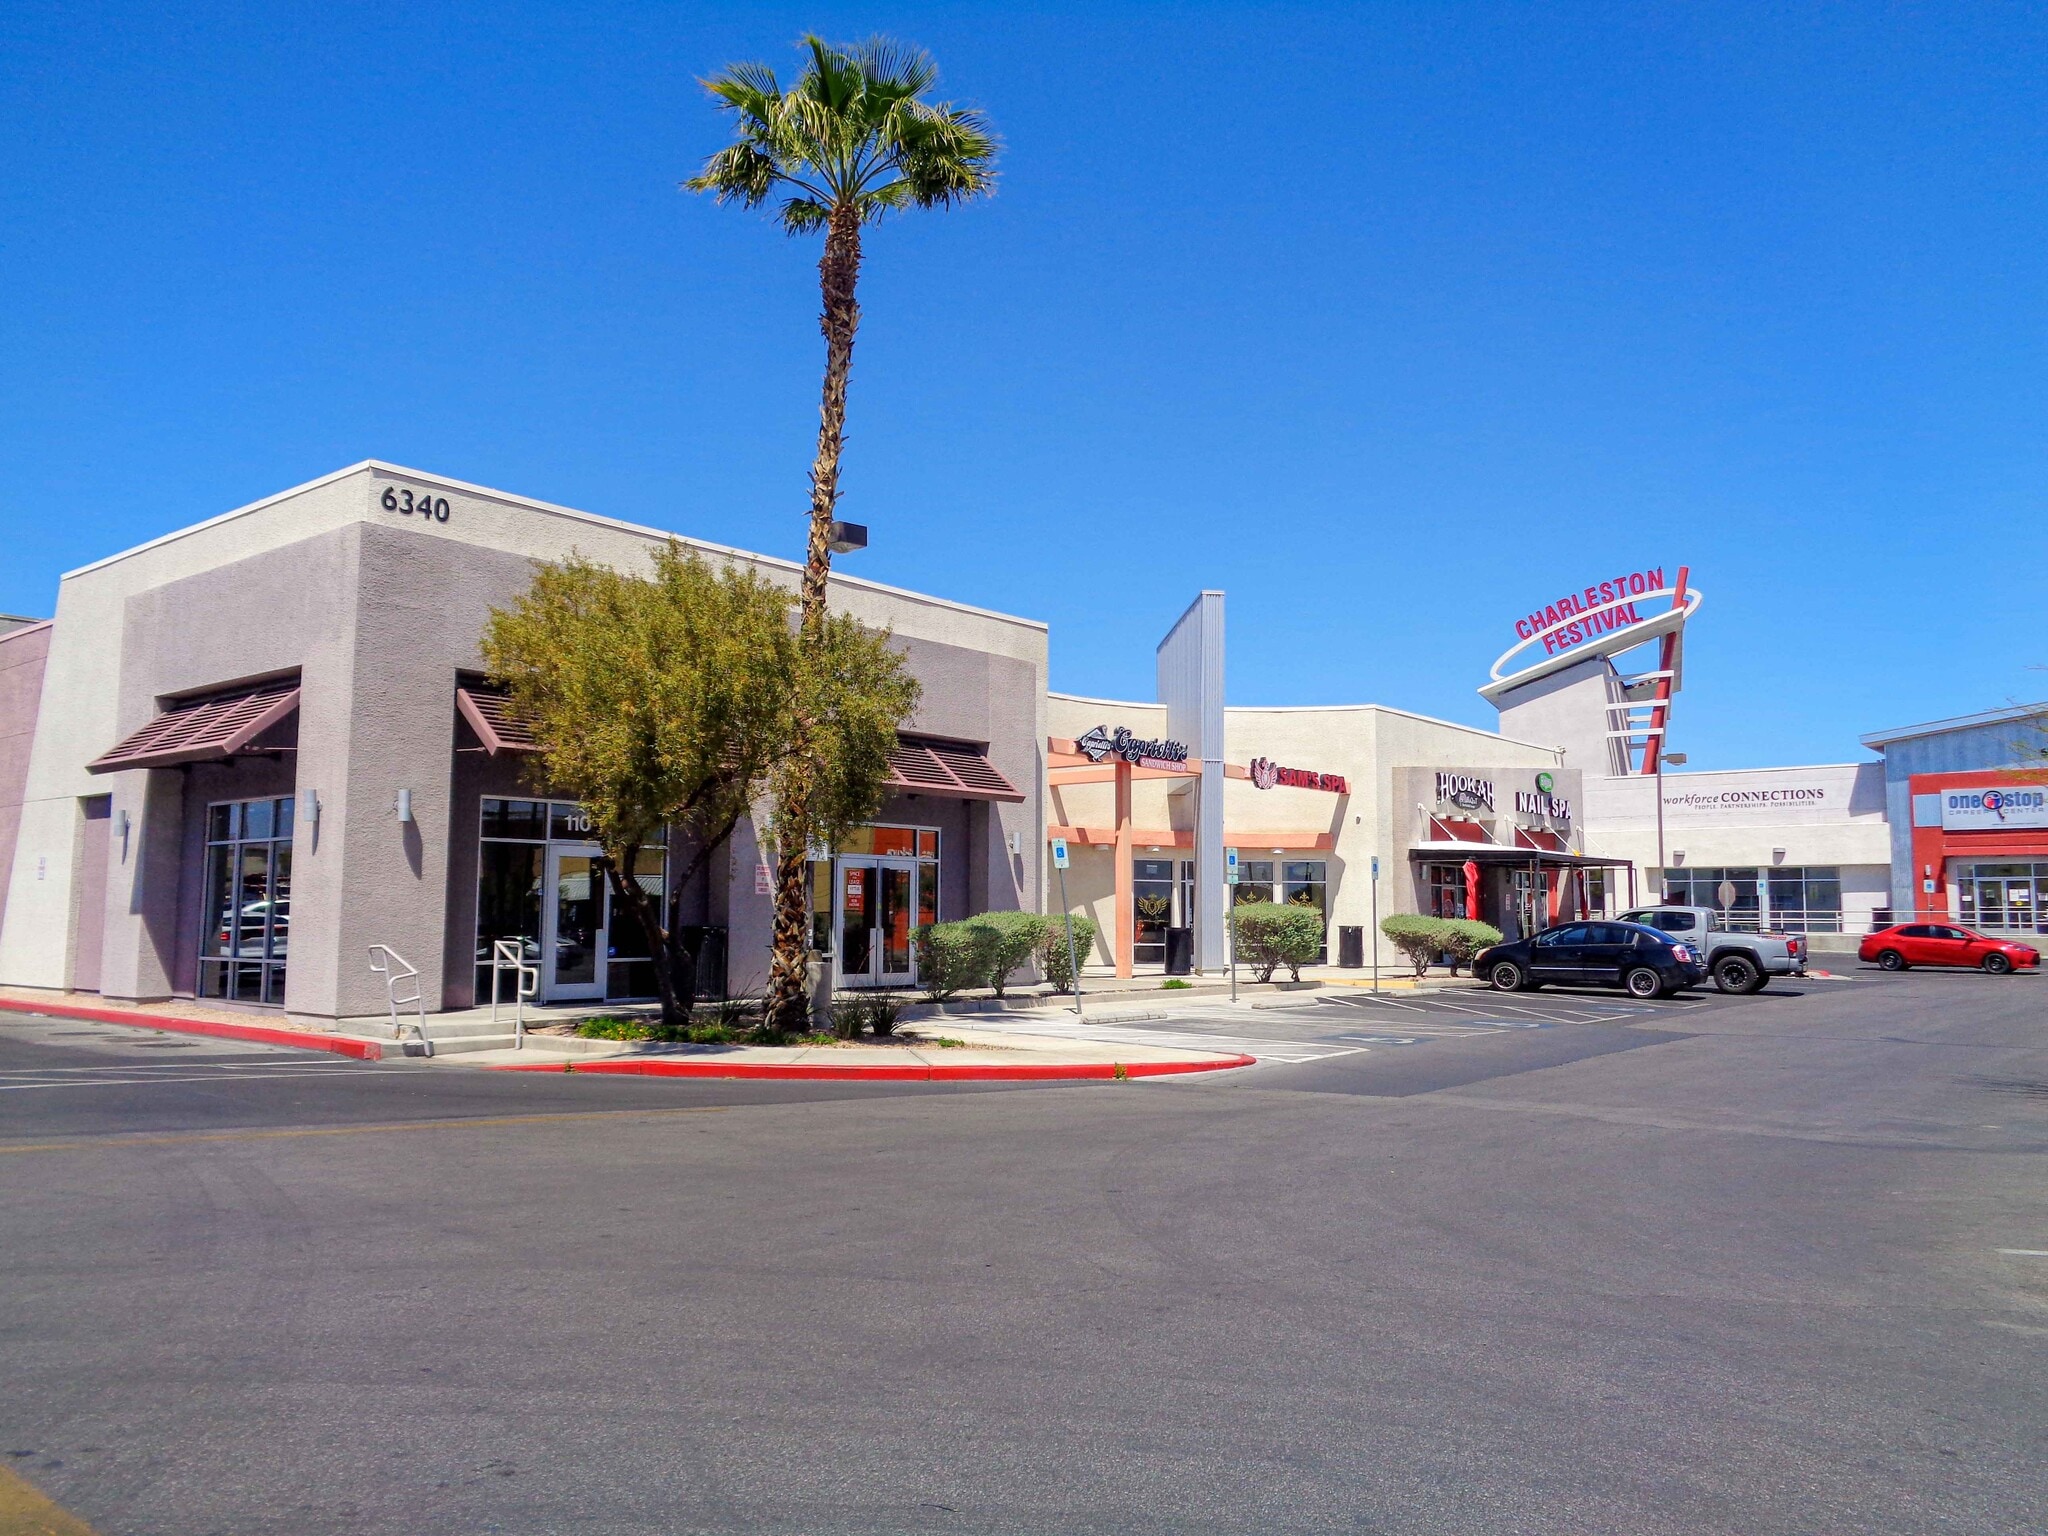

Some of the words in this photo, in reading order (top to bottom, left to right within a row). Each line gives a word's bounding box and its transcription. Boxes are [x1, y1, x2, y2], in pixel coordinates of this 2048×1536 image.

[381, 486, 450, 523] 6340
[1515, 568, 1664, 641] CHARLESTON
[1542, 602, 1644, 655] FESTIVAL
[1140, 758, 1171, 770] SANDWICH
[1171, 762, 1187, 772] SHOP
[1323, 774, 1347, 793] SPA
[1438, 772, 1495, 811] HOOKAH
[1518, 792, 1549, 815] NAIL
[1551, 798, 1573, 819] SPA
[1663, 793, 1718, 807] workforce
[1720, 789, 1824, 803] CONNECTIONS
[1948, 795, 1982, 809] one
[2003, 791, 2043, 808] stop
[564, 814, 592, 832] 110
